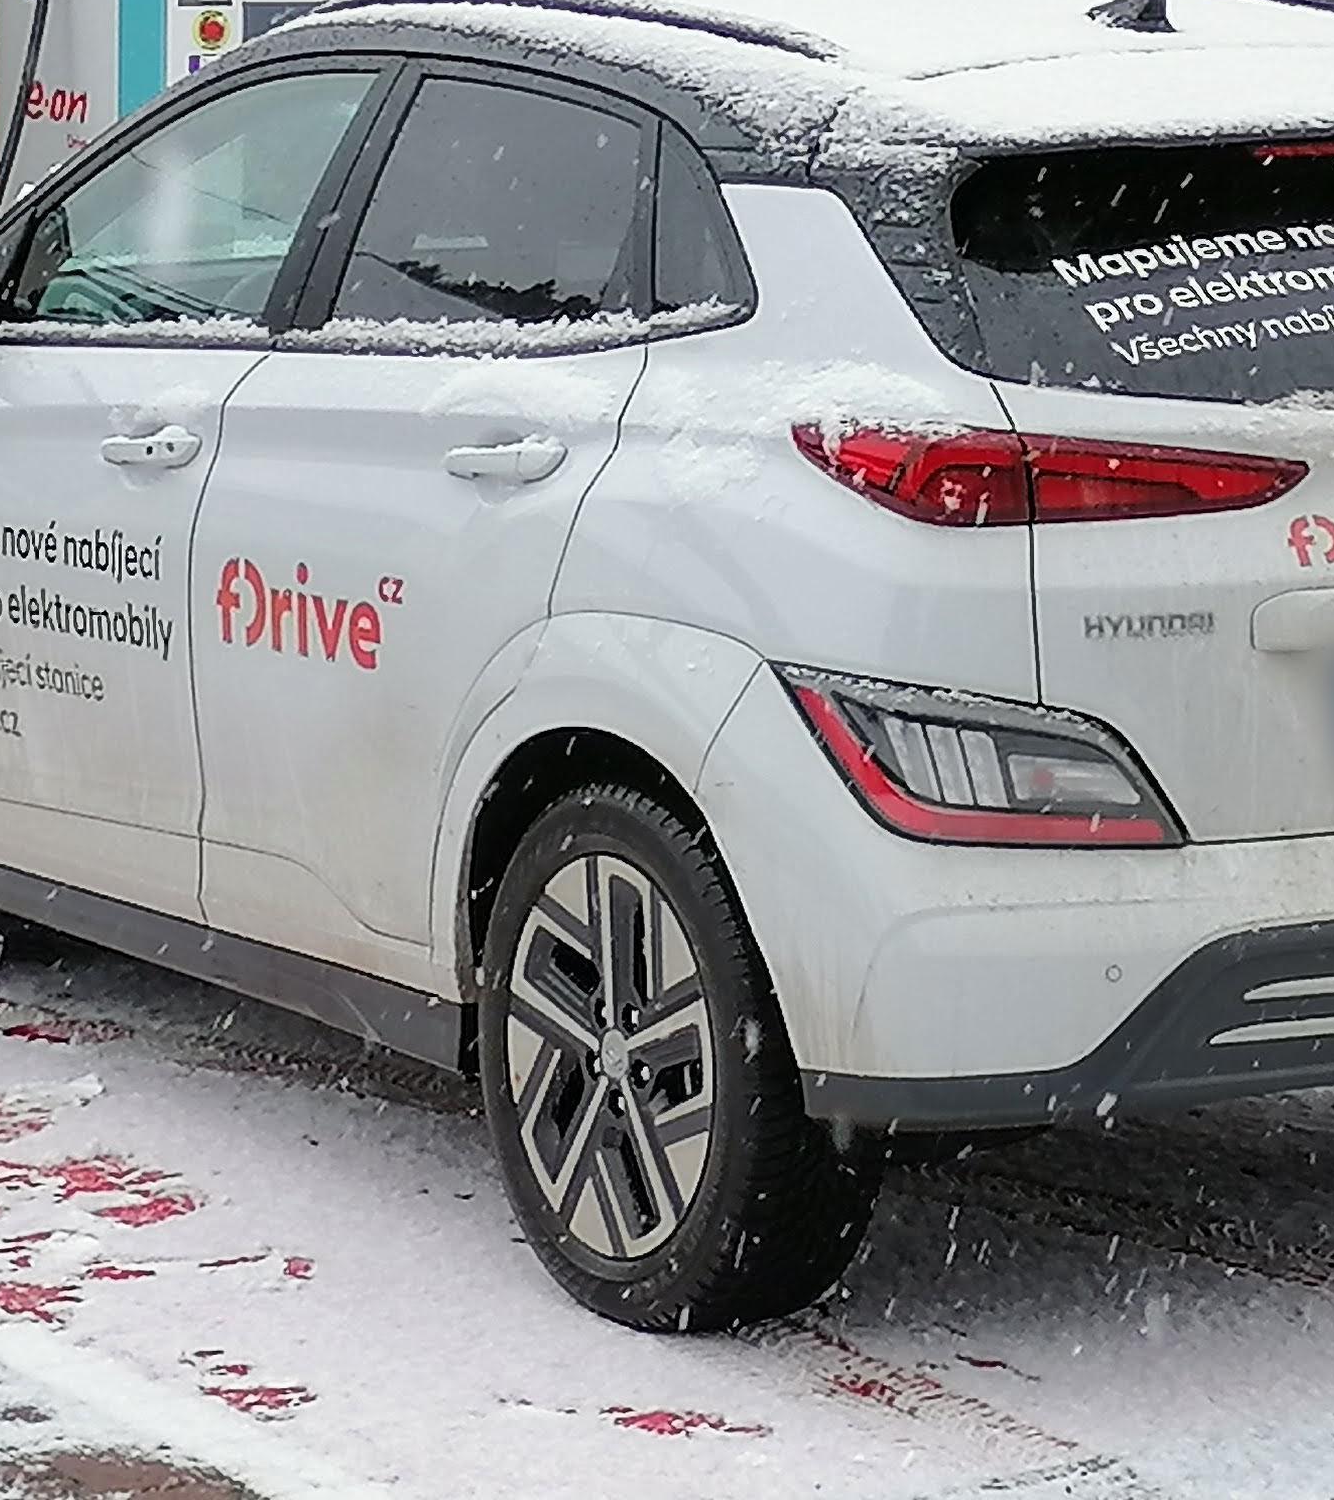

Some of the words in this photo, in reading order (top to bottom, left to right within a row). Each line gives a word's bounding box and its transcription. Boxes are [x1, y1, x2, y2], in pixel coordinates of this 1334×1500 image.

[1052, 230, 1287, 287] Mapujeme
[1084, 293, 1164, 332] pro
[1110, 321, 1258, 366] Všechny
[2, 520, 58, 563] nové
[63, 528, 163, 583] nabíjecí
[8, 584, 173, 661] elektromobily
[1083, 612, 1214, 639] HYUNDAI
[36, 662, 105, 701] stanice
